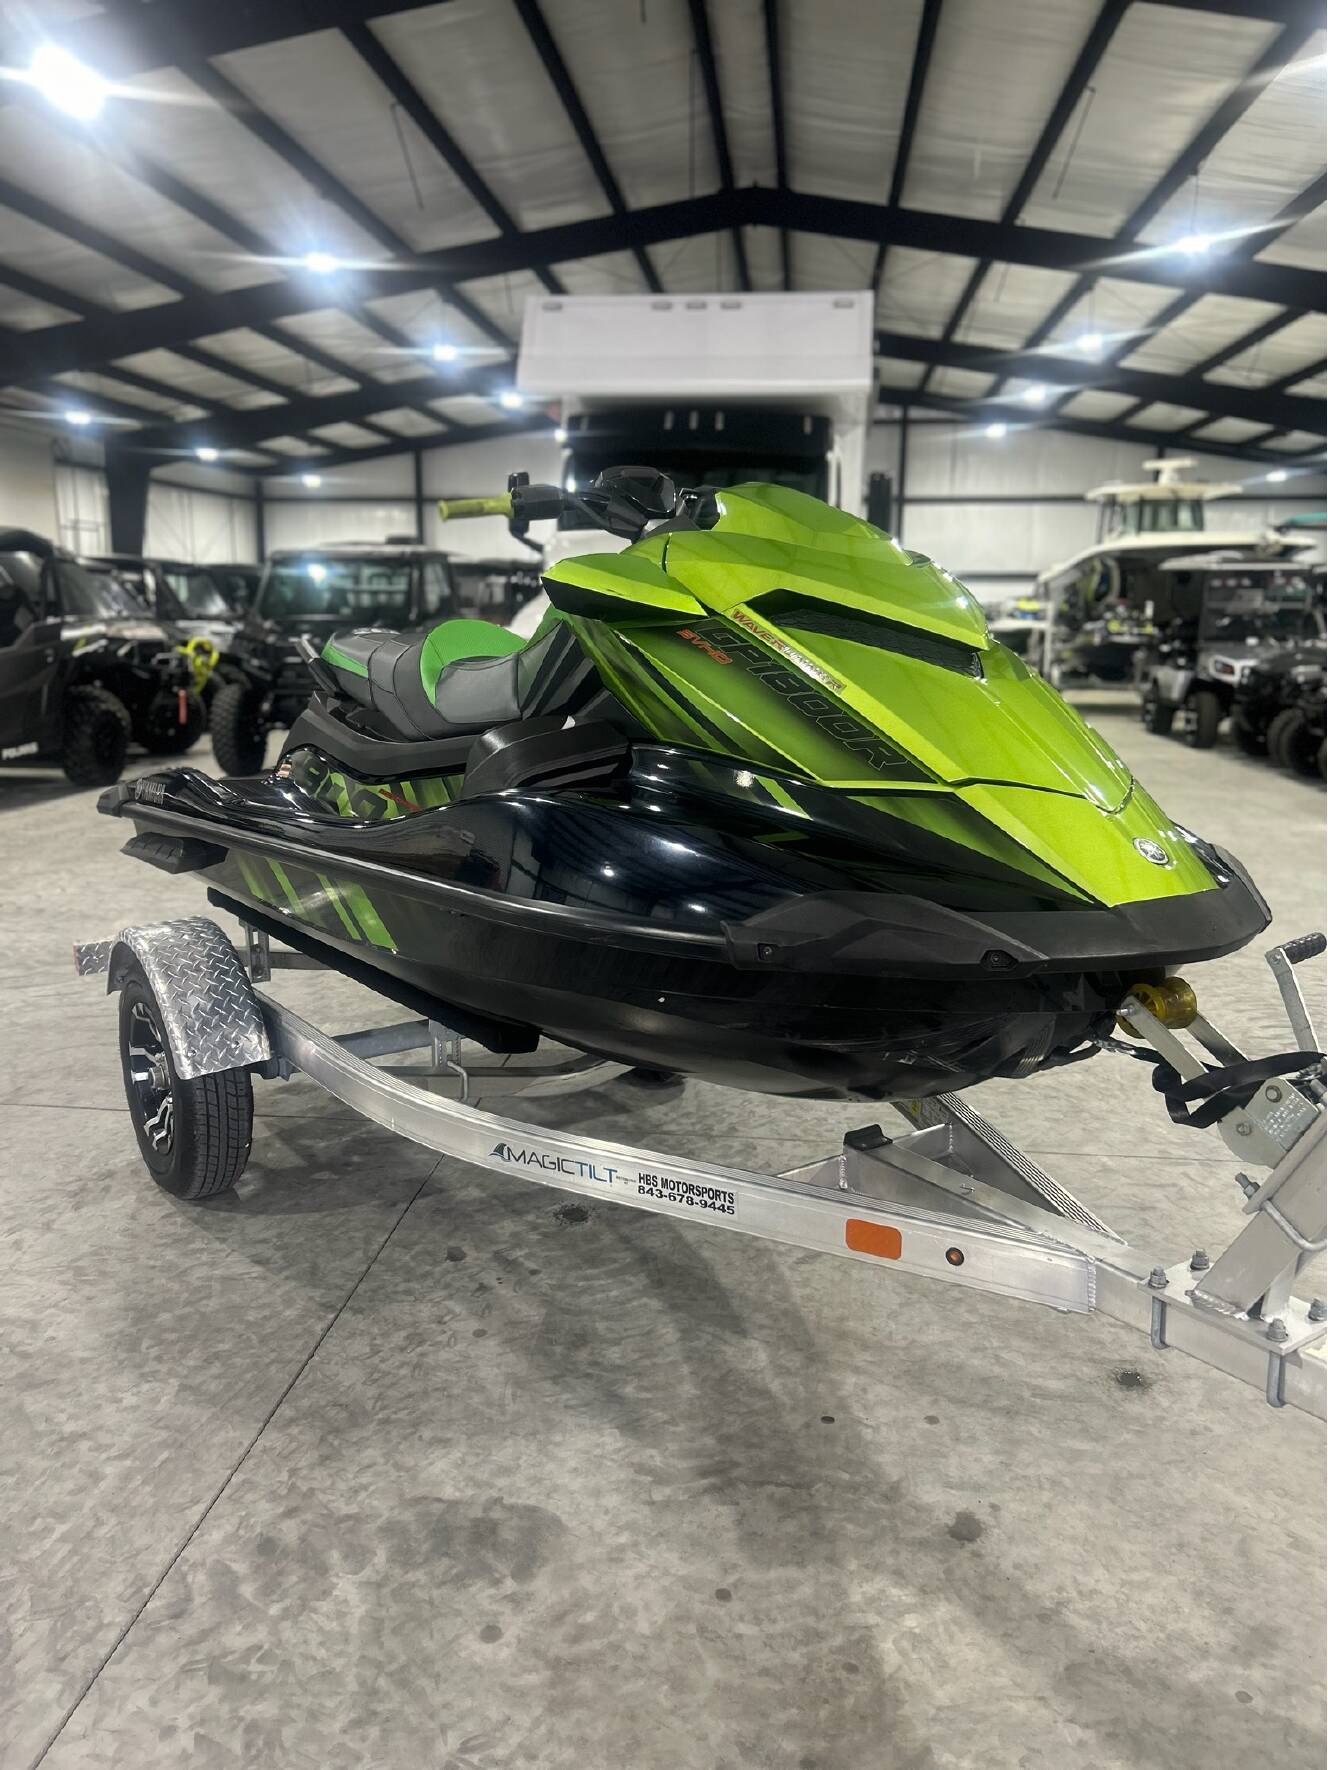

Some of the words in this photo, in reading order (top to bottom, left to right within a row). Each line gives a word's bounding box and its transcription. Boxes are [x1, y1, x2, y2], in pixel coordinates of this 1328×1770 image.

[506, 1146, 618, 1184] MAGICTILT
[637, 1185, 735, 1215] 843-678-9445
[638, 1172, 658, 1188] HBS
[660, 1177, 735, 1205] MOTORSPORTS
